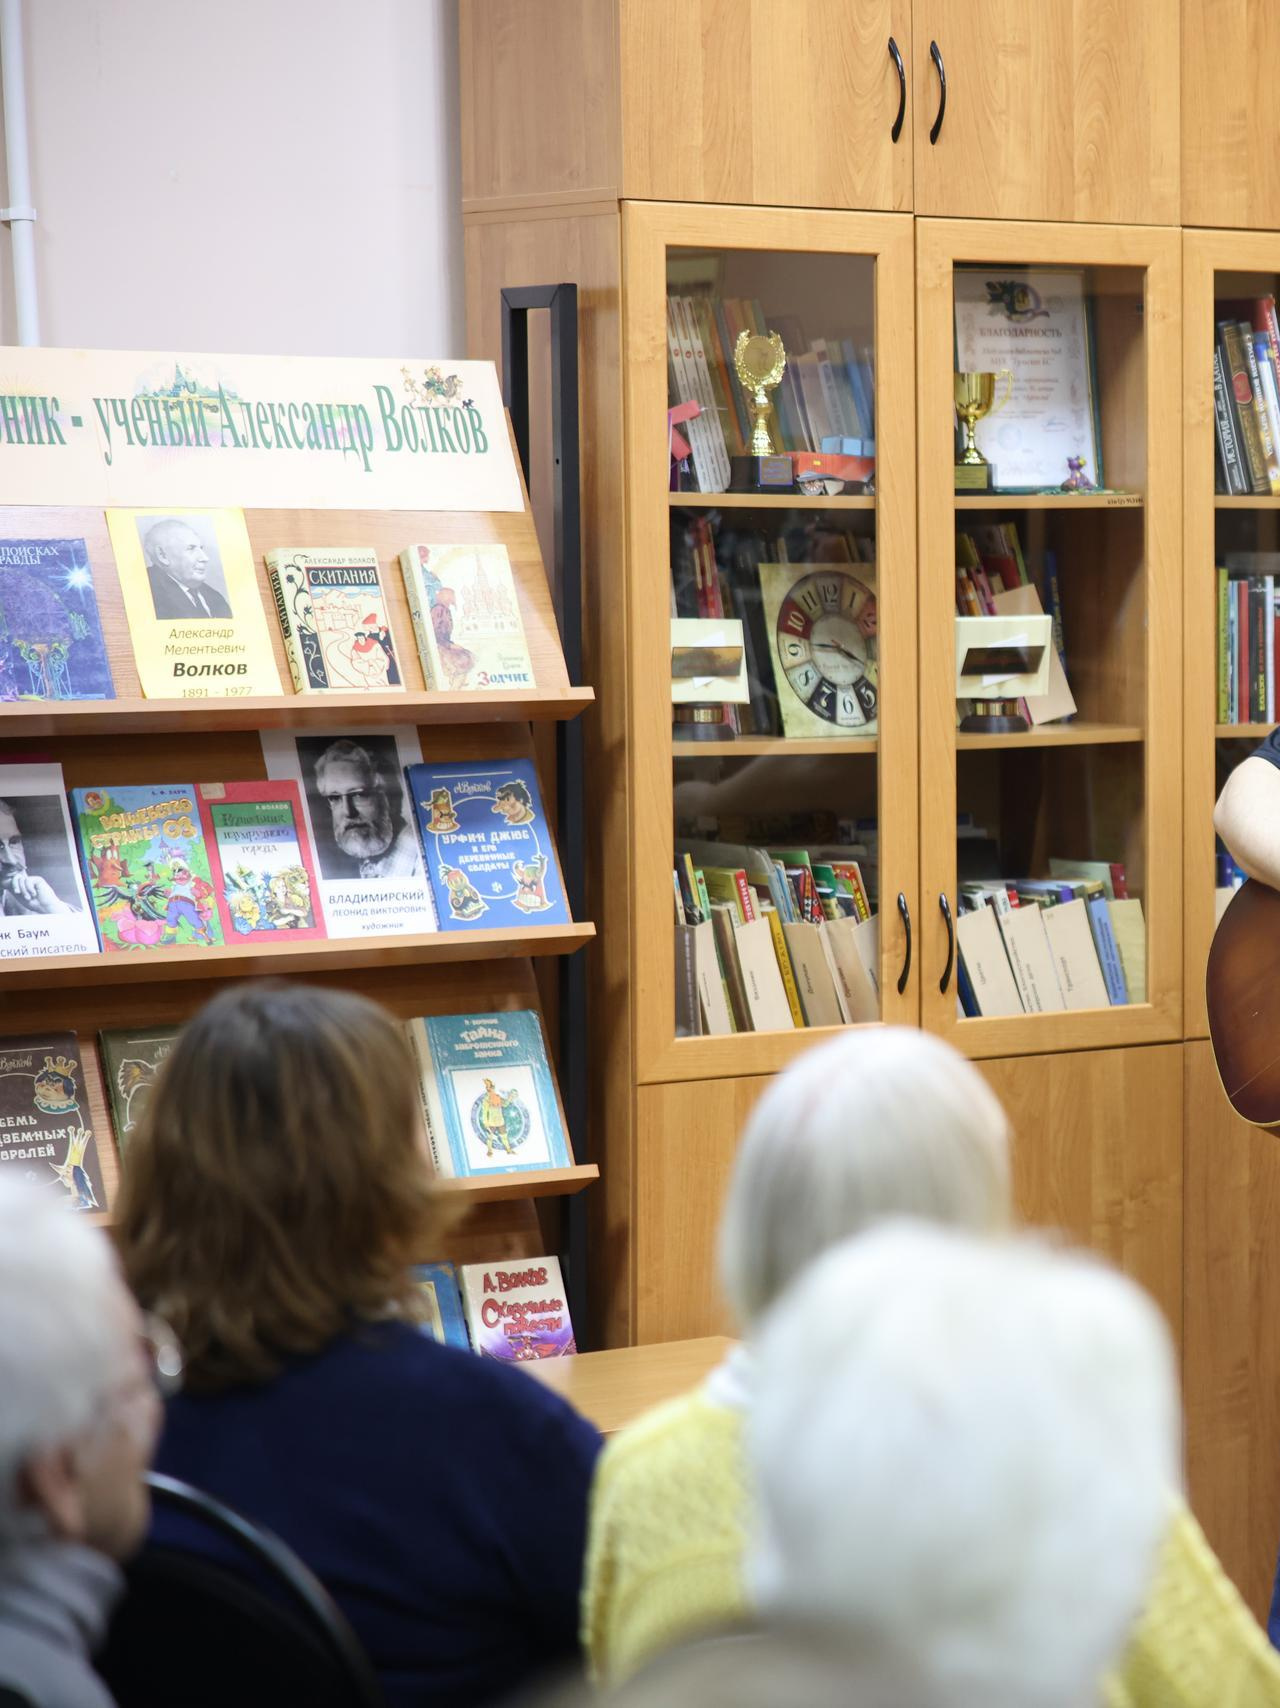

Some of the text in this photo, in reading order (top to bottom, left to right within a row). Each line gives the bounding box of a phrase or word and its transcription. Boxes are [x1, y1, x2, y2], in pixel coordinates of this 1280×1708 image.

[979, 327, 1063, 338] БЛАГОДАРНОСТЬ
[0, 395, 67, 445] ник
[217, 381, 374, 472] Александр
[372, 385, 488, 454] Волков
[1220, 419, 1236, 465] ИСТОРИЯ
[1, 546, 59, 556] ПОИСКАХ
[0, 555, 41, 566] РАВДЫ
[304, 557, 346, 565] АЛЕКСАНДР
[309, 569, 378, 585] СКИТАНИЯ
[802, 590, 818, 612] 11
[822, 584, 838, 603] 12
[271, 571, 292, 639] СКИТАНИЯ
[787, 611, 806, 631] 10
[169, 628, 234, 640] Александр
[164, 645, 246, 656] Мелентьевич
[173, 662, 248, 678] Волков
[182, 687, 209, 698] 1891
[224, 686, 253, 697] 1977
[820, 686, 832, 708] 7
[842, 695, 854, 714] 6
[99, 798, 192, 831] ВОЛШЕБСТВО
[90, 824, 160, 848] СТРАНЫ
[442, 832, 486, 844] УРФИН
[467, 863, 510, 872] СОЛДАТЫ
[329, 889, 425, 905] ВЛАДИМИРСКИЙ
[332, 906, 427, 917] ЛЕОНИД ВИКТОРОВИЧ
[362, 921, 404, 931] художник
[17, 929, 50, 940] Баум
[0, 943, 87, 957] ский писатель
[0, 1129, 67, 1146] ЗЕМНЫХ
[0, 1144, 56, 1161] ОРОЛЕЙ
